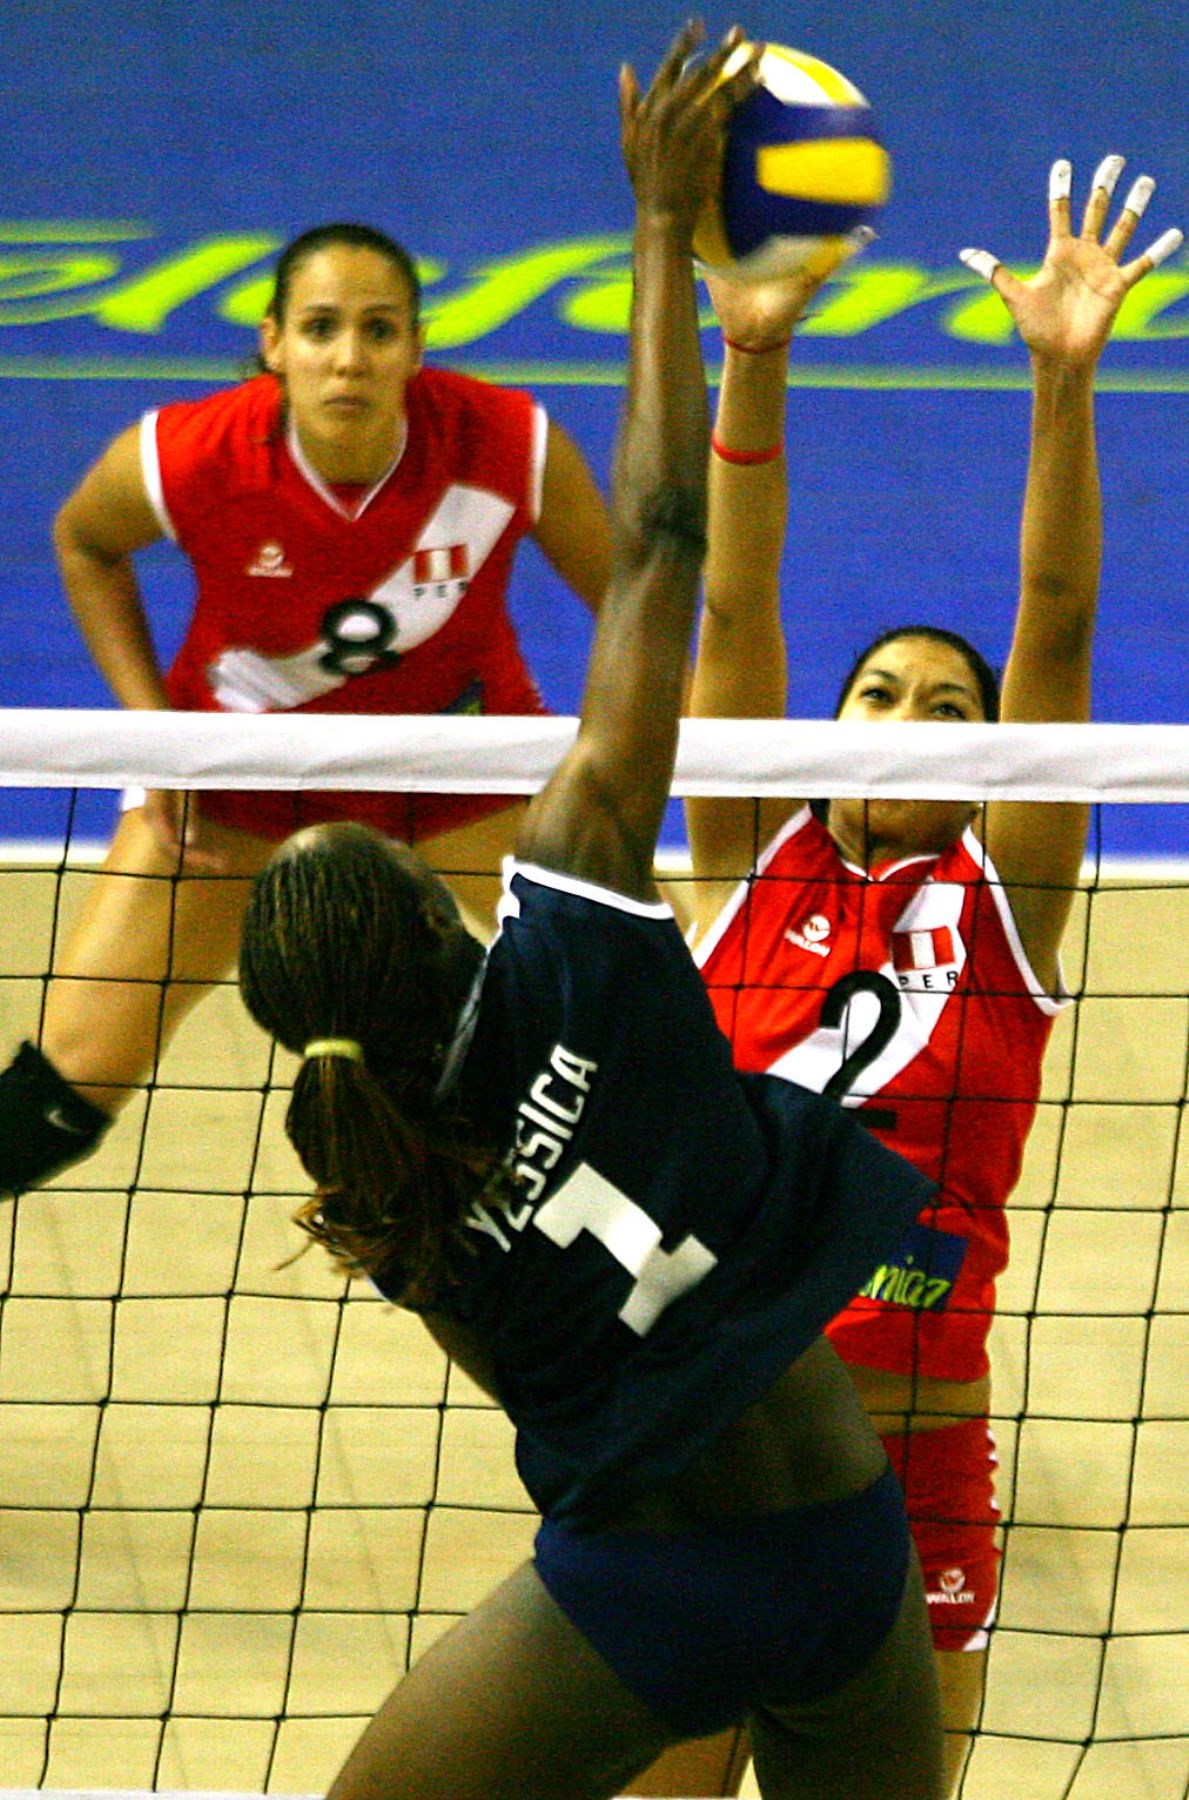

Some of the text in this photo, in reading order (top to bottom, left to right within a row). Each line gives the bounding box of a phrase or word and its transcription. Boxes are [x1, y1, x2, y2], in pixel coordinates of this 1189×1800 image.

[319, 597, 400, 676] 8
[898, 970, 958, 990] PER
[819, 969, 901, 1130] 2
[532, 1161, 719, 1338] 1
